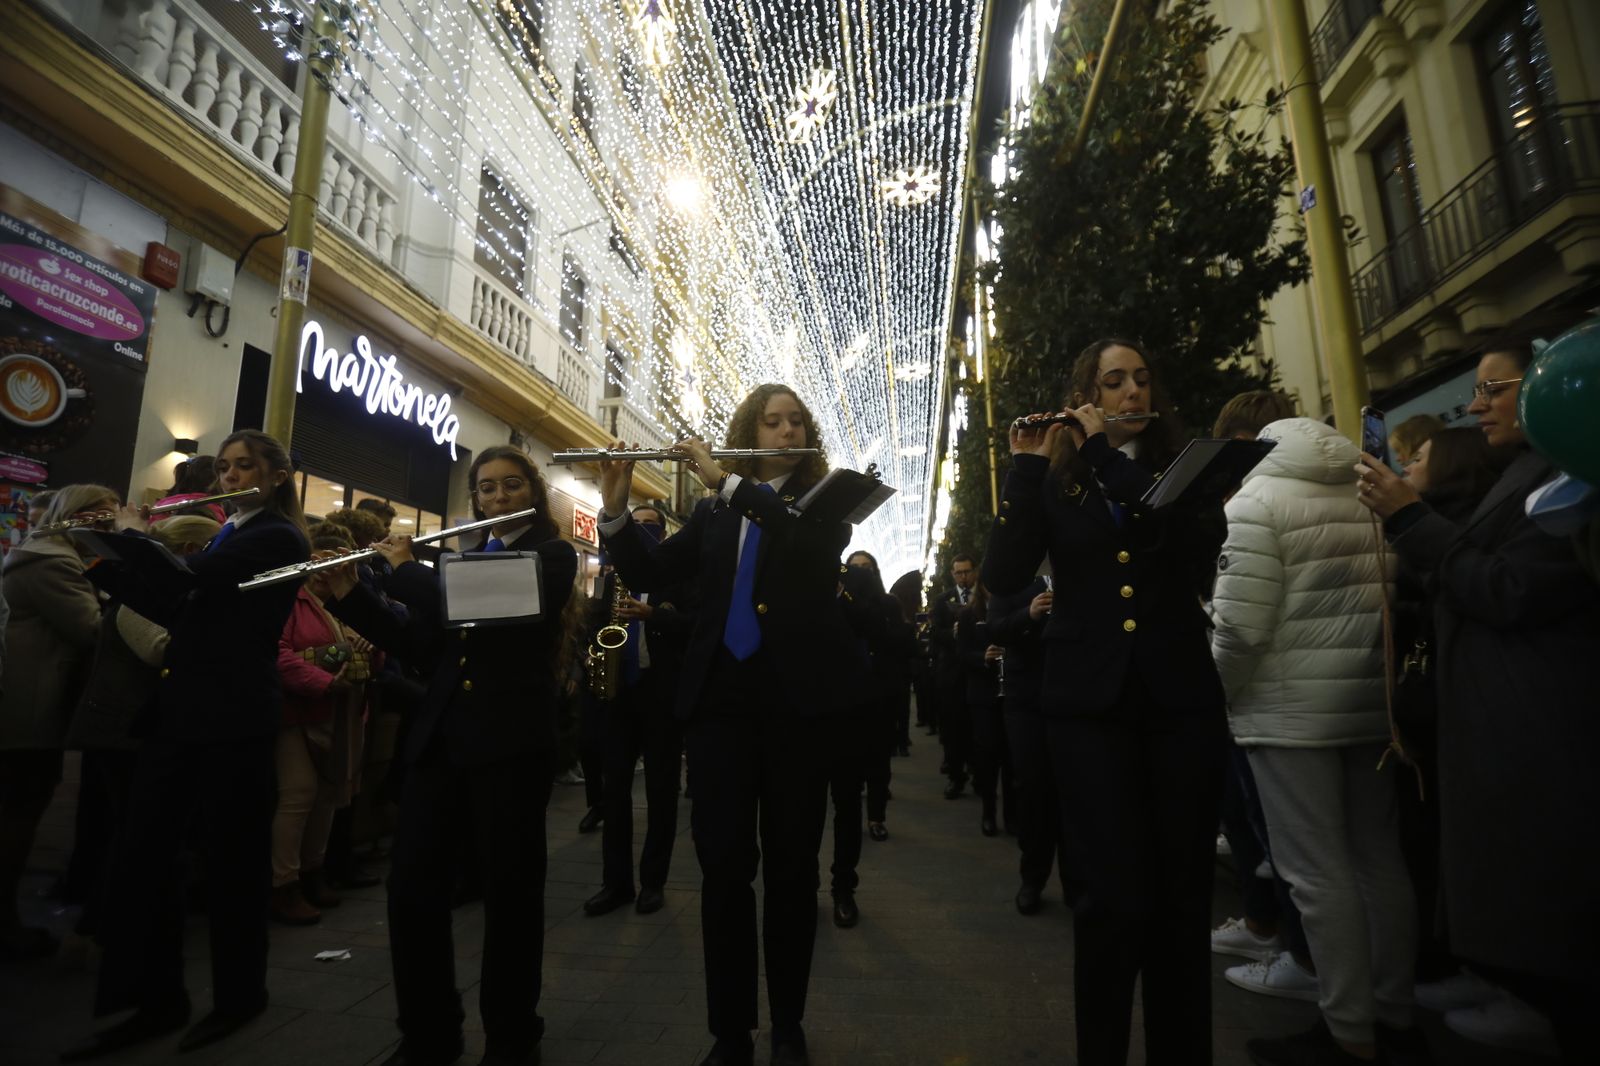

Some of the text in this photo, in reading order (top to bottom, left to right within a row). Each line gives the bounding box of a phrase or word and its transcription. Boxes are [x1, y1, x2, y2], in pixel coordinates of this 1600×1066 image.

[27, 231, 43, 245] de
[46, 239, 83, 264] 15.000
[85, 260, 128, 286] artículos
[0, 260, 138, 332] roticacruzconde.es
[84, 279, 109, 297] shop
[36, 297, 95, 329] Parafarmacia
[114, 342, 143, 361] Online
[296, 320, 459, 462] Martonela
